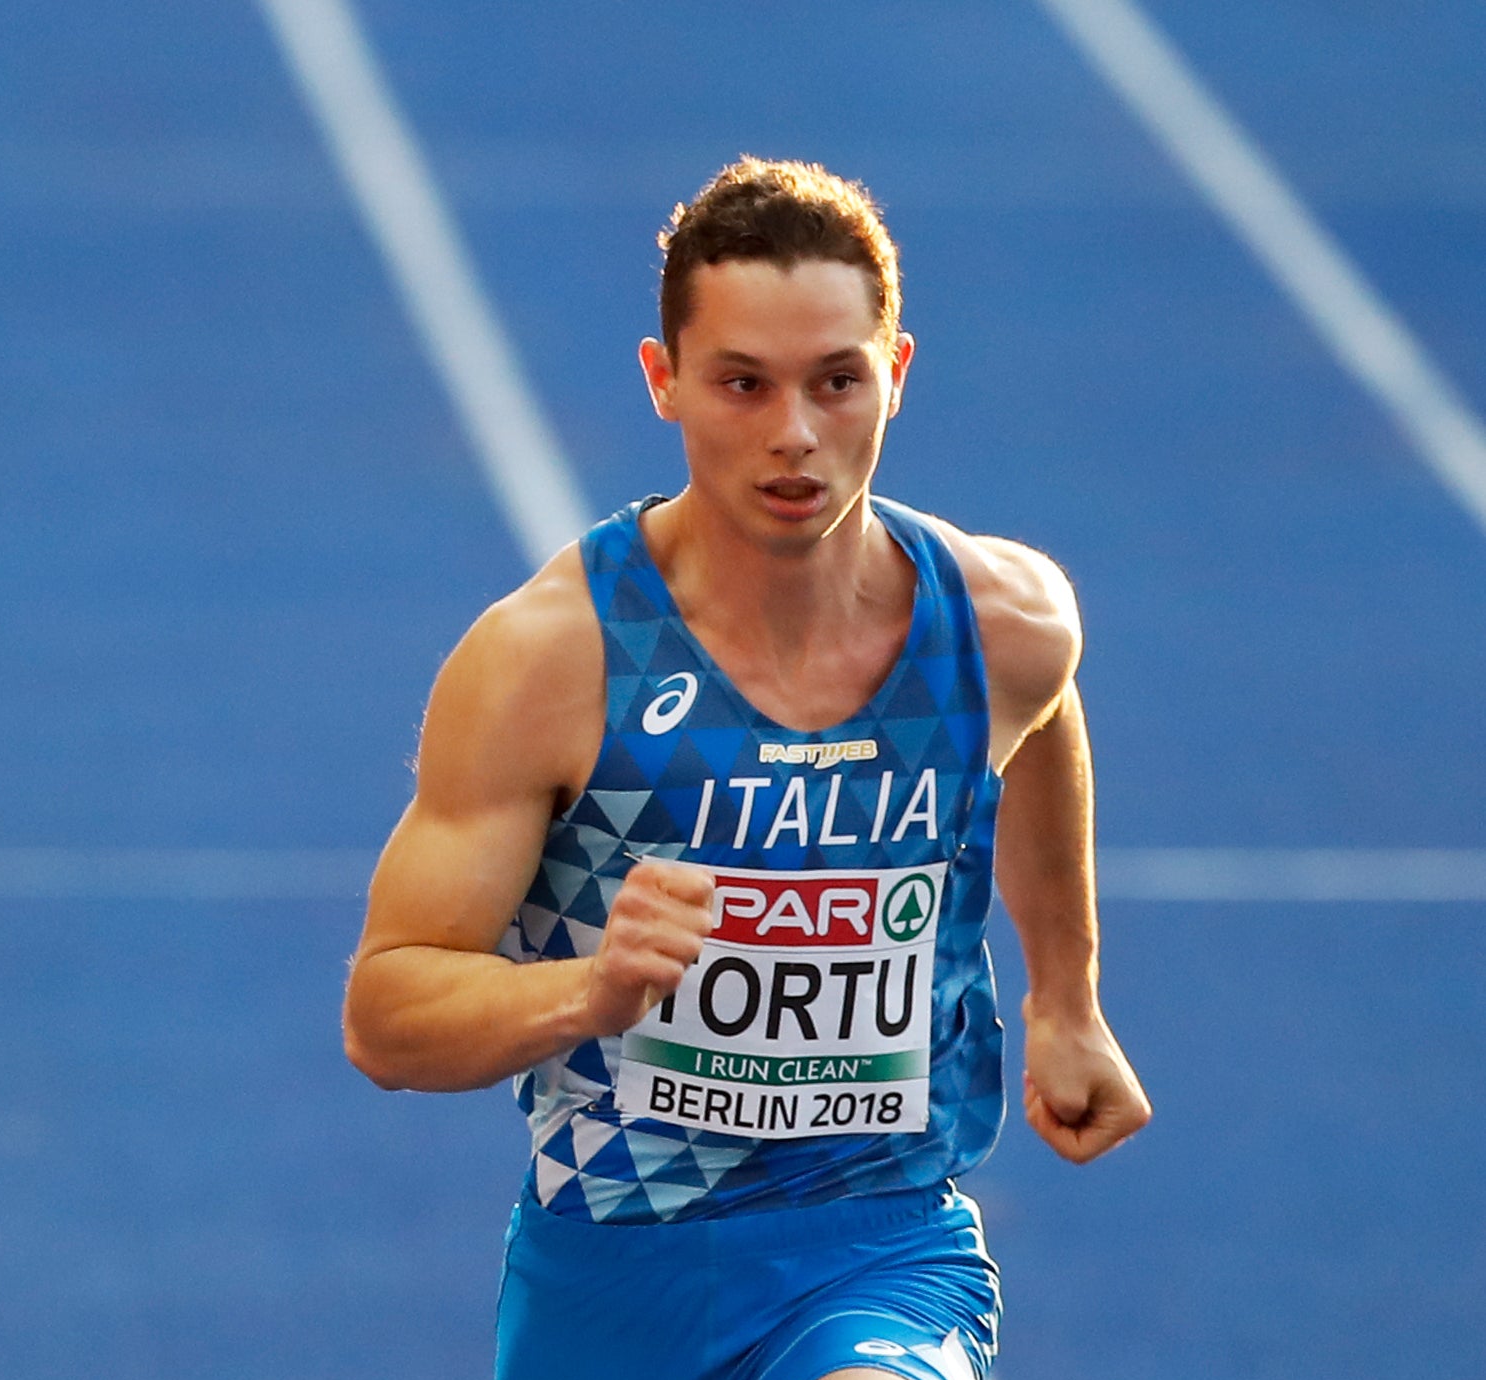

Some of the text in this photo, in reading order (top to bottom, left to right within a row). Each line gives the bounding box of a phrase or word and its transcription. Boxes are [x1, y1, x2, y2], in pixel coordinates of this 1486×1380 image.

[760, 741, 877, 769] FASTWEB
[689, 767, 939, 850] ITALIA
[712, 888, 871, 936] PAR
[694, 1052, 703, 1072] I
[710, 1054, 770, 1081] RUN
[649, 1075, 903, 1131] BERLIN 2018
